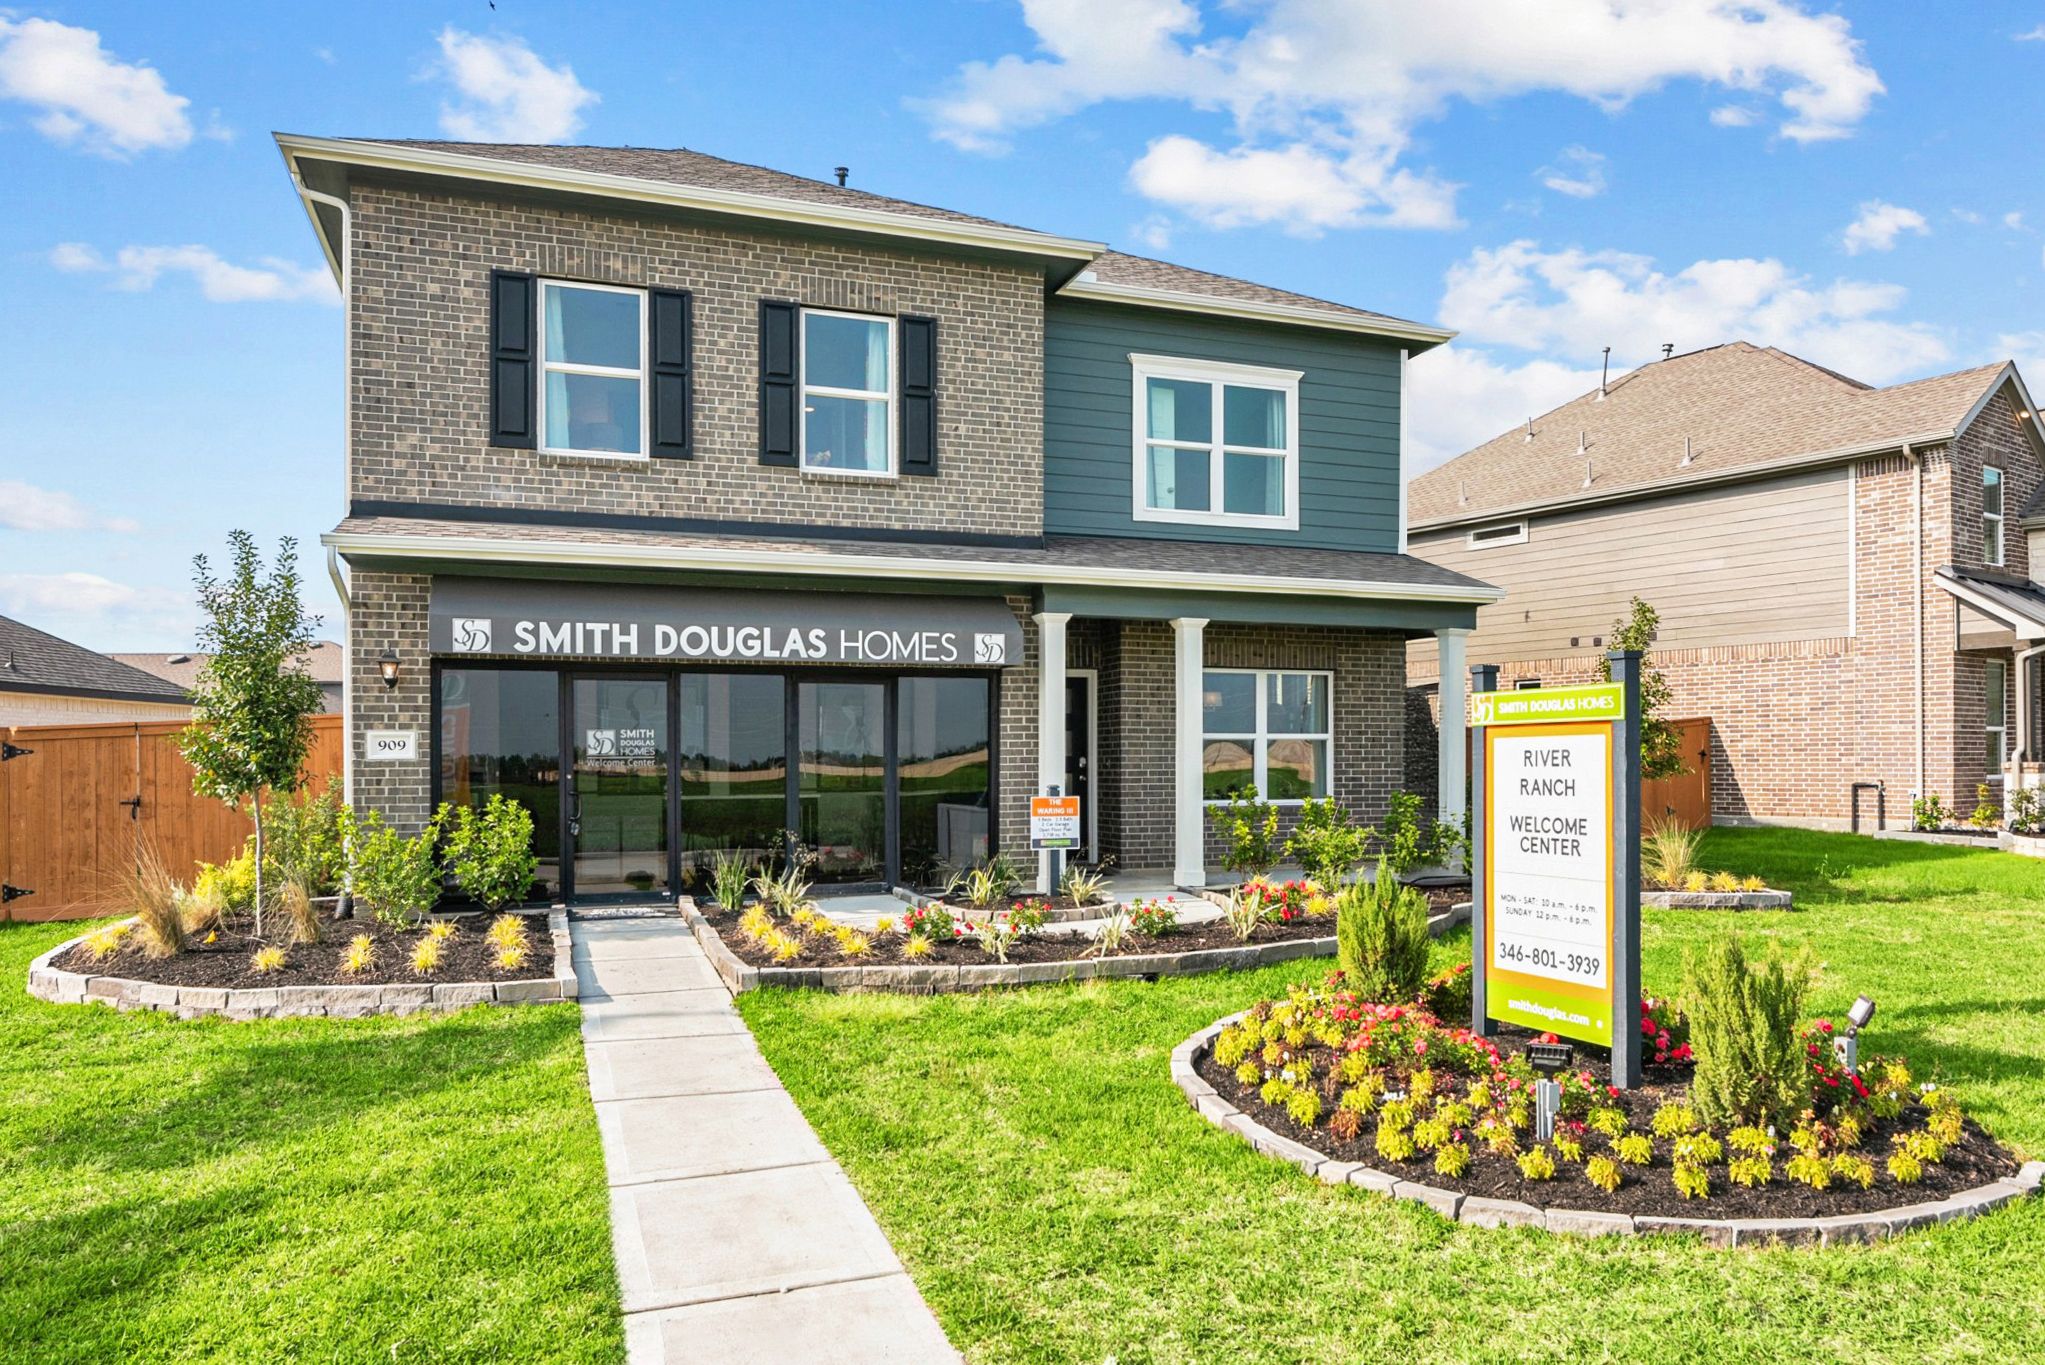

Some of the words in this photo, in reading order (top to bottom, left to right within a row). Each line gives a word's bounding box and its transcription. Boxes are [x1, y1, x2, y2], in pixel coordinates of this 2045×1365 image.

[513, 620, 638, 655] SMITH
[655, 624, 826, 659] DOUGLAS
[840, 629, 958, 662] HOMES
[1498, 702, 1528, 714] SMITH
[1530, 700, 1576, 713] DOUGLAS
[1578, 696, 1615, 709] HOMES
[620, 729, 654, 738] SMITH
[378, 740, 406, 751] 909
[620, 747, 656, 756] HOMES
[587, 759, 625, 768] Welcome
[628, 759, 656, 767] Center
[1523, 749, 1571, 767] RIVER
[1520, 778, 1576, 796] RANCH
[1509, 815, 1588, 836] WELCOME
[1520, 836, 1582, 857] CENTER
[1500, 894, 1517, 903] MON
[1541, 898, 1550, 907] 10
[1551, 901, 1567, 909] a.m.
[1581, 905, 1598, 913] p.m.
[1505, 906, 1532, 917] SUNDAY
[1536, 910, 1543, 919] 12
[1545, 912, 1561, 921] p.m.
[1575, 917, 1592, 926] p.m.
[1499, 942, 1600, 976] 346-801-3939
[1508, 998, 1590, 1027] smithdouglas.com
